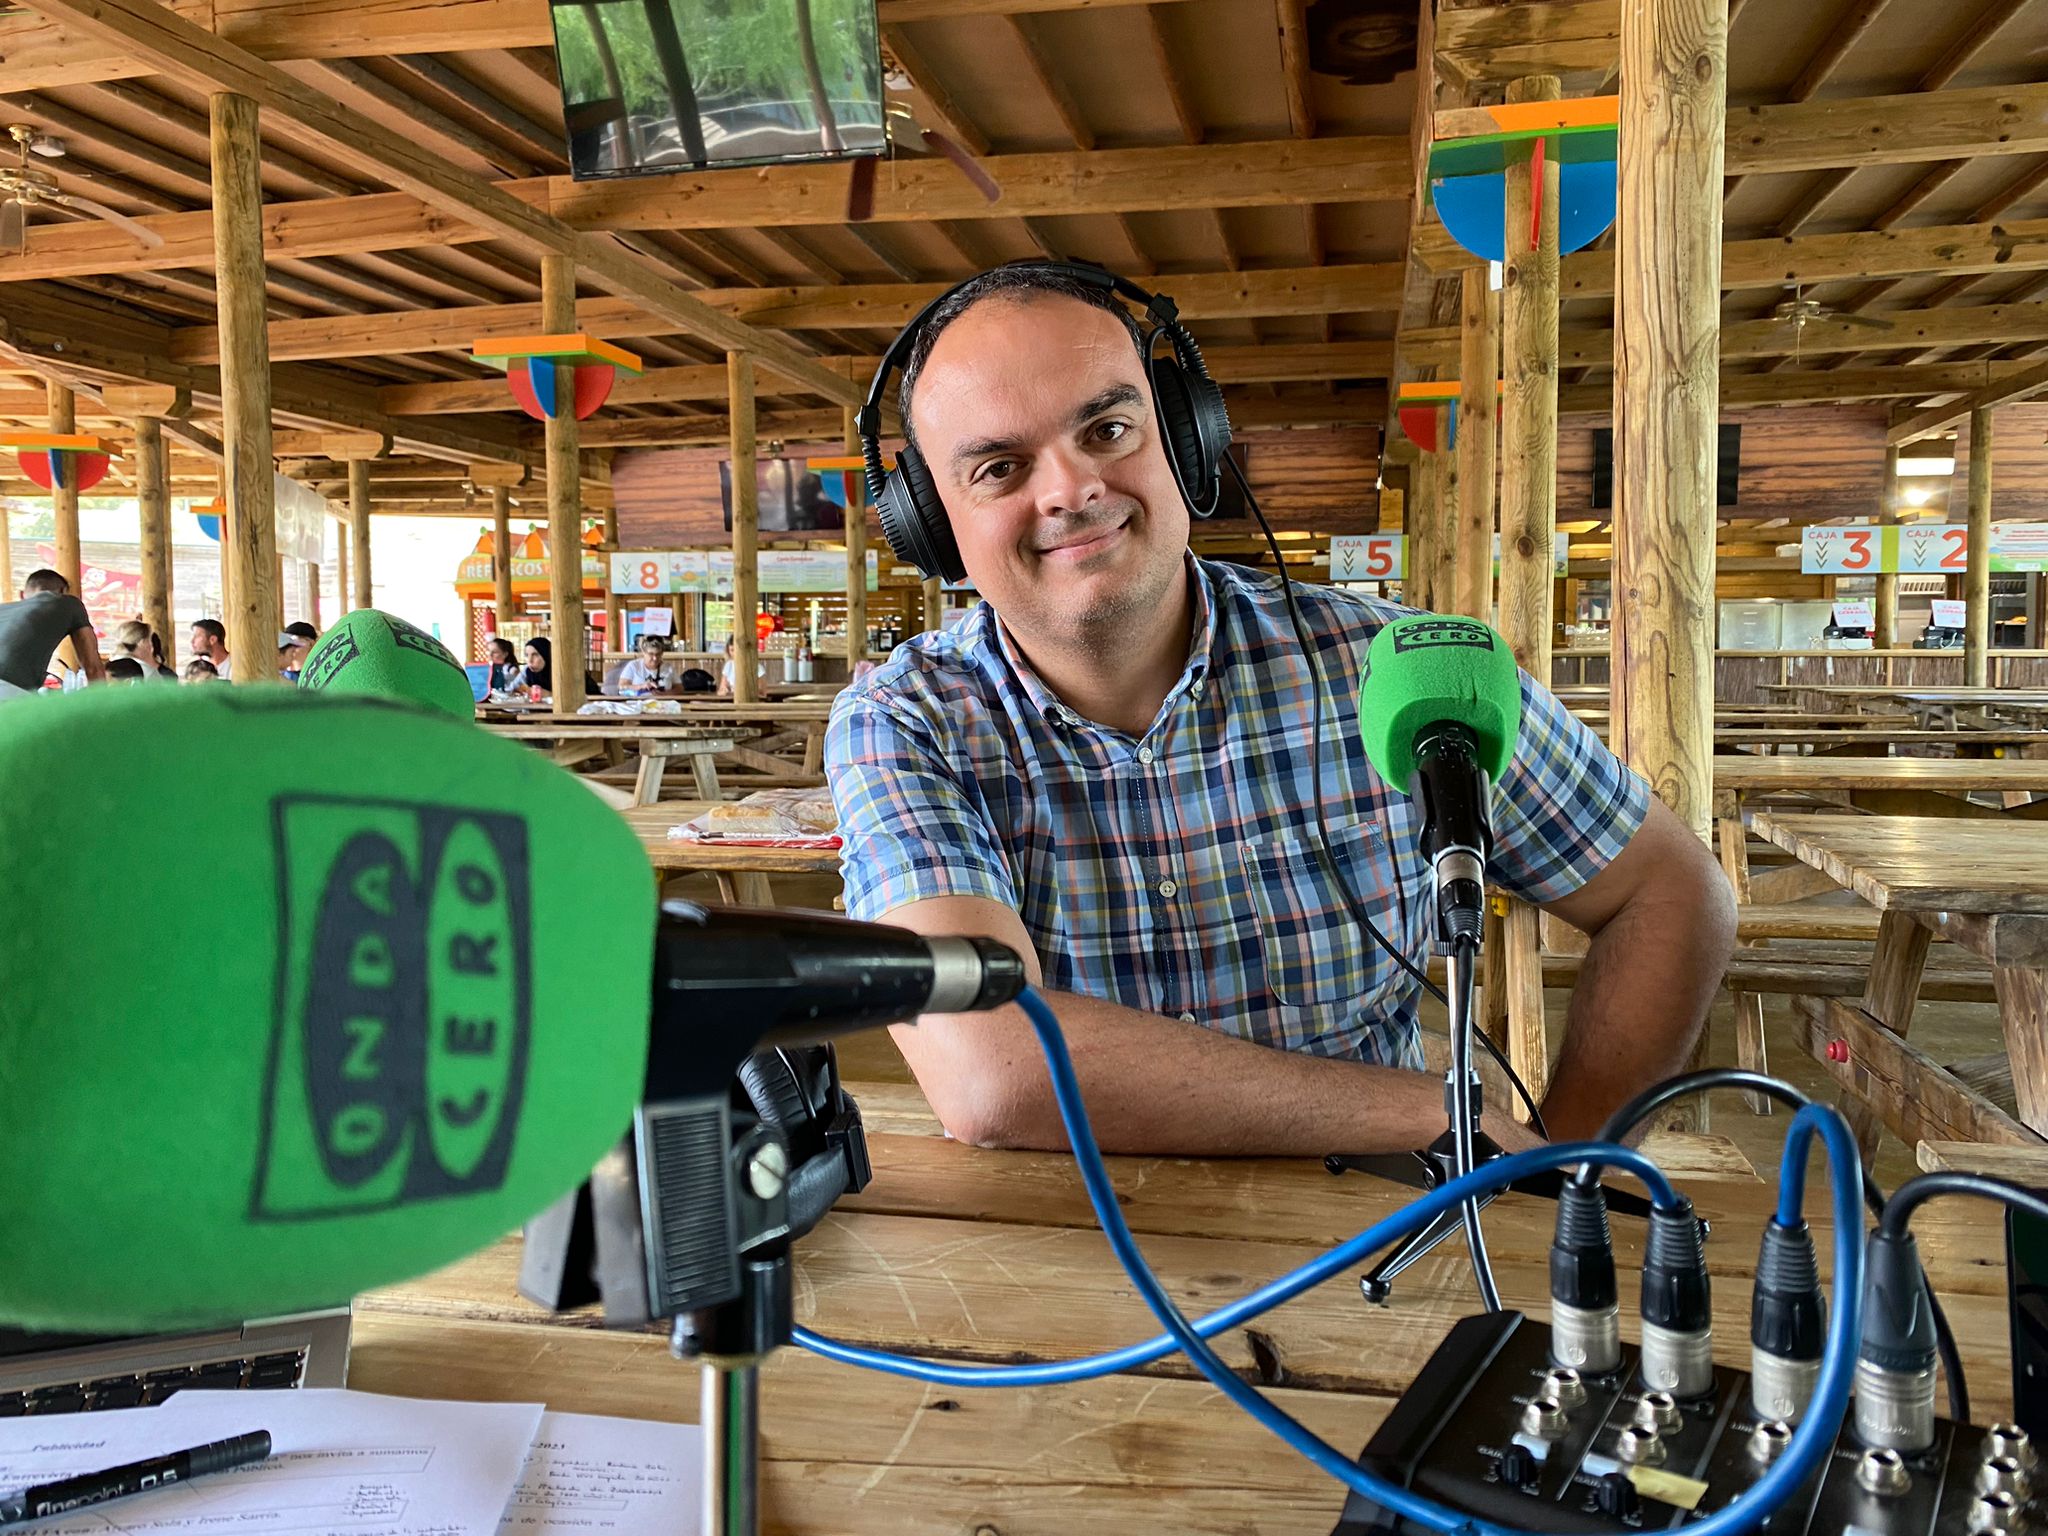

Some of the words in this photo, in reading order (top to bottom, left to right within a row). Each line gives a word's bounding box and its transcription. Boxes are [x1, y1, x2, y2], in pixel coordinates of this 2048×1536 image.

[1336, 540, 1363, 548] CAJA
[1366, 540, 1393, 576] 5
[1808, 531, 1837, 540] CAJA
[1841, 530, 1872, 569] 3
[1907, 529, 1936, 538] CAJA
[1939, 529, 1968, 568] 2
[466, 562, 543, 578] REFSCOS
[640, 561, 660, 590] 8
[1407, 622, 1479, 632] ONDA
[1412, 632, 1479, 642] CERO
[313, 649, 343, 688] ERO
[327, 862, 396, 1158] ONDA
[438, 862, 498, 1129] CERO
